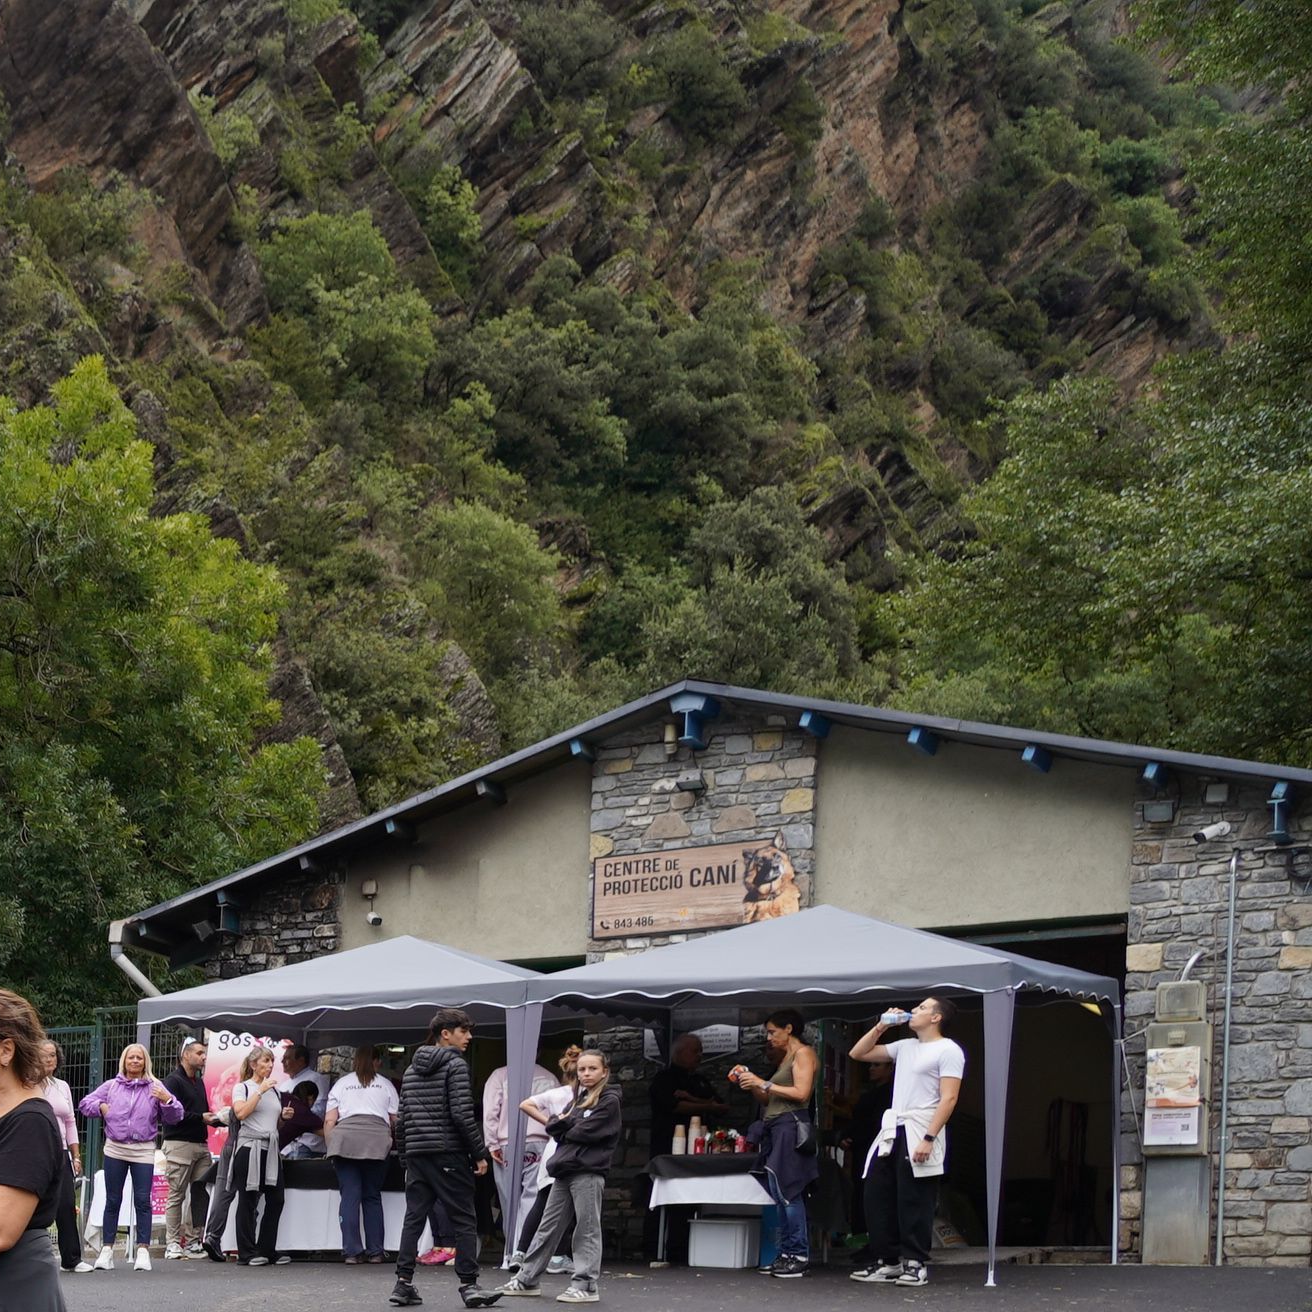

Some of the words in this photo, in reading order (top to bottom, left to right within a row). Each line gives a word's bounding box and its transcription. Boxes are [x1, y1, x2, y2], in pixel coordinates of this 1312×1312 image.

[604, 858, 661, 878] CENTRE
[665, 859, 680, 872] DE
[603, 871, 683, 897] PROTECCIÓ
[689, 860, 739, 888] CANÍ
[614, 917, 632, 929] 843
[635, 915, 654, 927] 486
